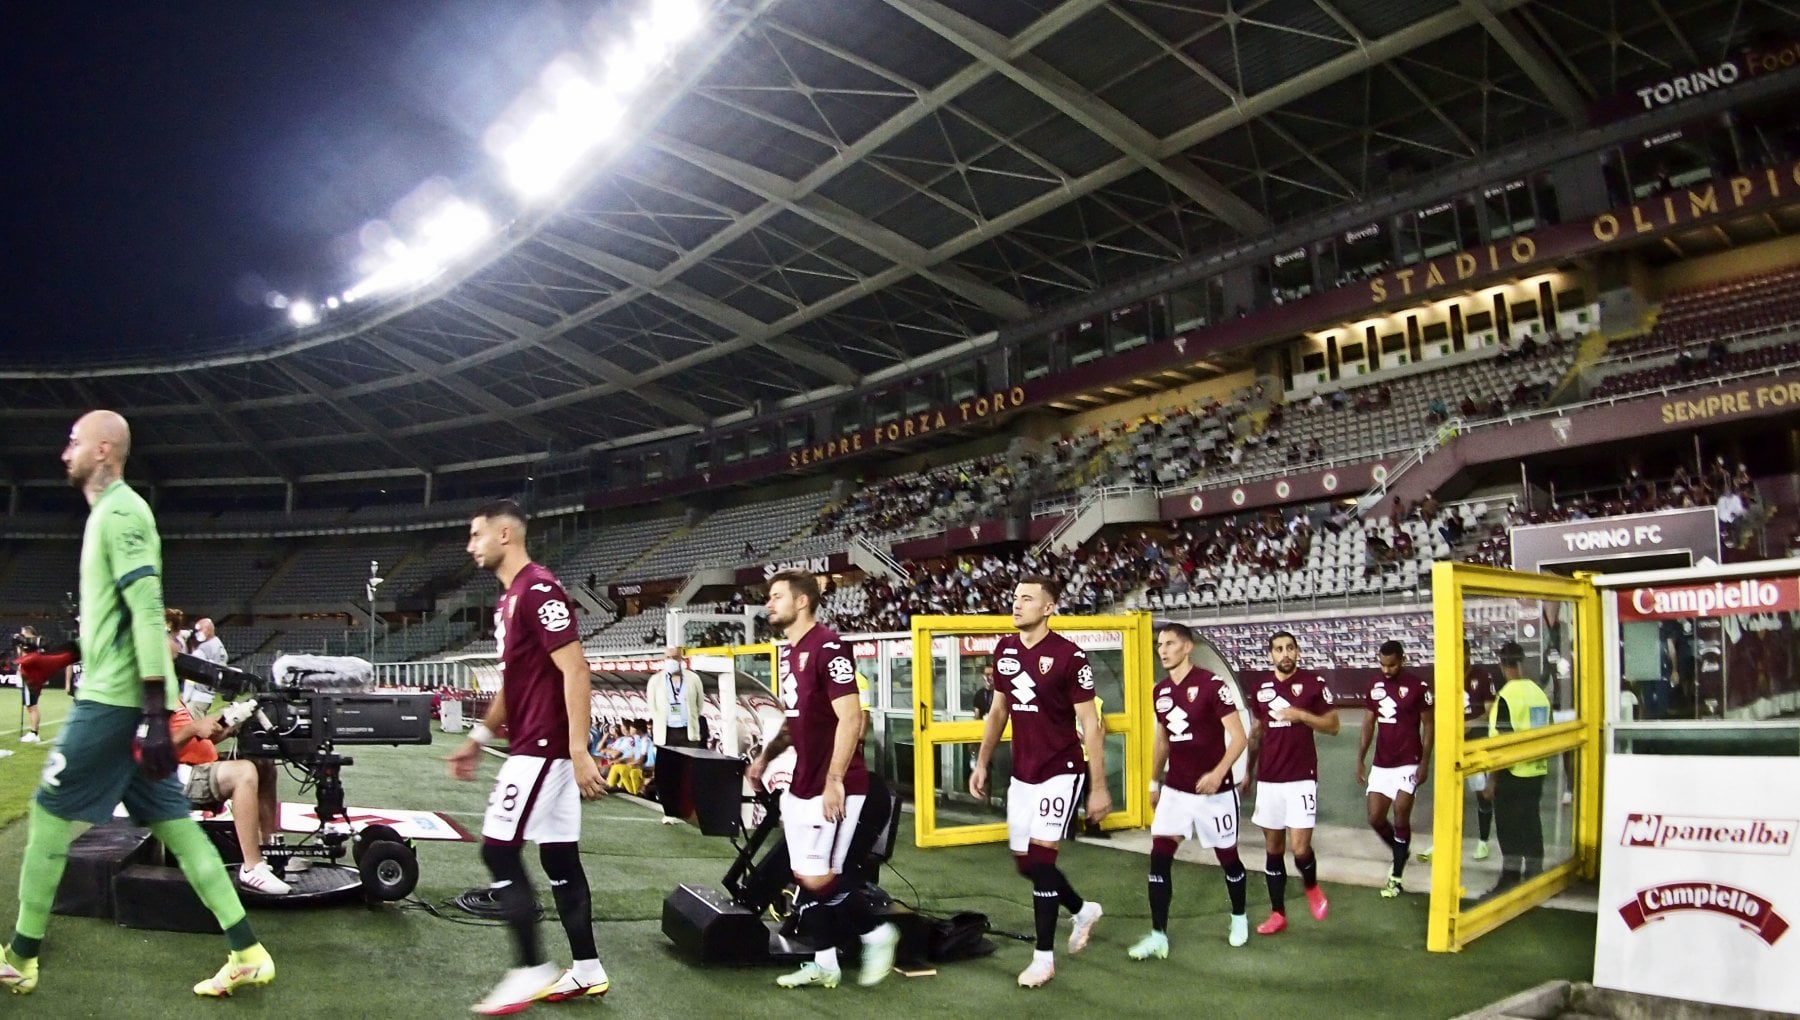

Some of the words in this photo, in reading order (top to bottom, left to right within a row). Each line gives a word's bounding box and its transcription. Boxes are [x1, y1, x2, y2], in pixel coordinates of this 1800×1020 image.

[1636, 61, 1739, 110] TORINO
[1369, 236, 1536, 303] STADIO
[1661, 390, 1751, 424] SEMPRE
[790, 433, 862, 467] SEMPRE
[874, 410, 947, 444] FORZA
[958, 386, 1025, 421] TORO
[1563, 527, 1630, 551] TORINO
[1634, 524, 1663, 546] FC
[1632, 579, 1779, 617] Campiello
[1039, 797, 1065, 818] 99
[1301, 793, 1315, 811] 13
[1213, 813, 1233, 834] 10
[1643, 883, 1760, 917] Campiello
